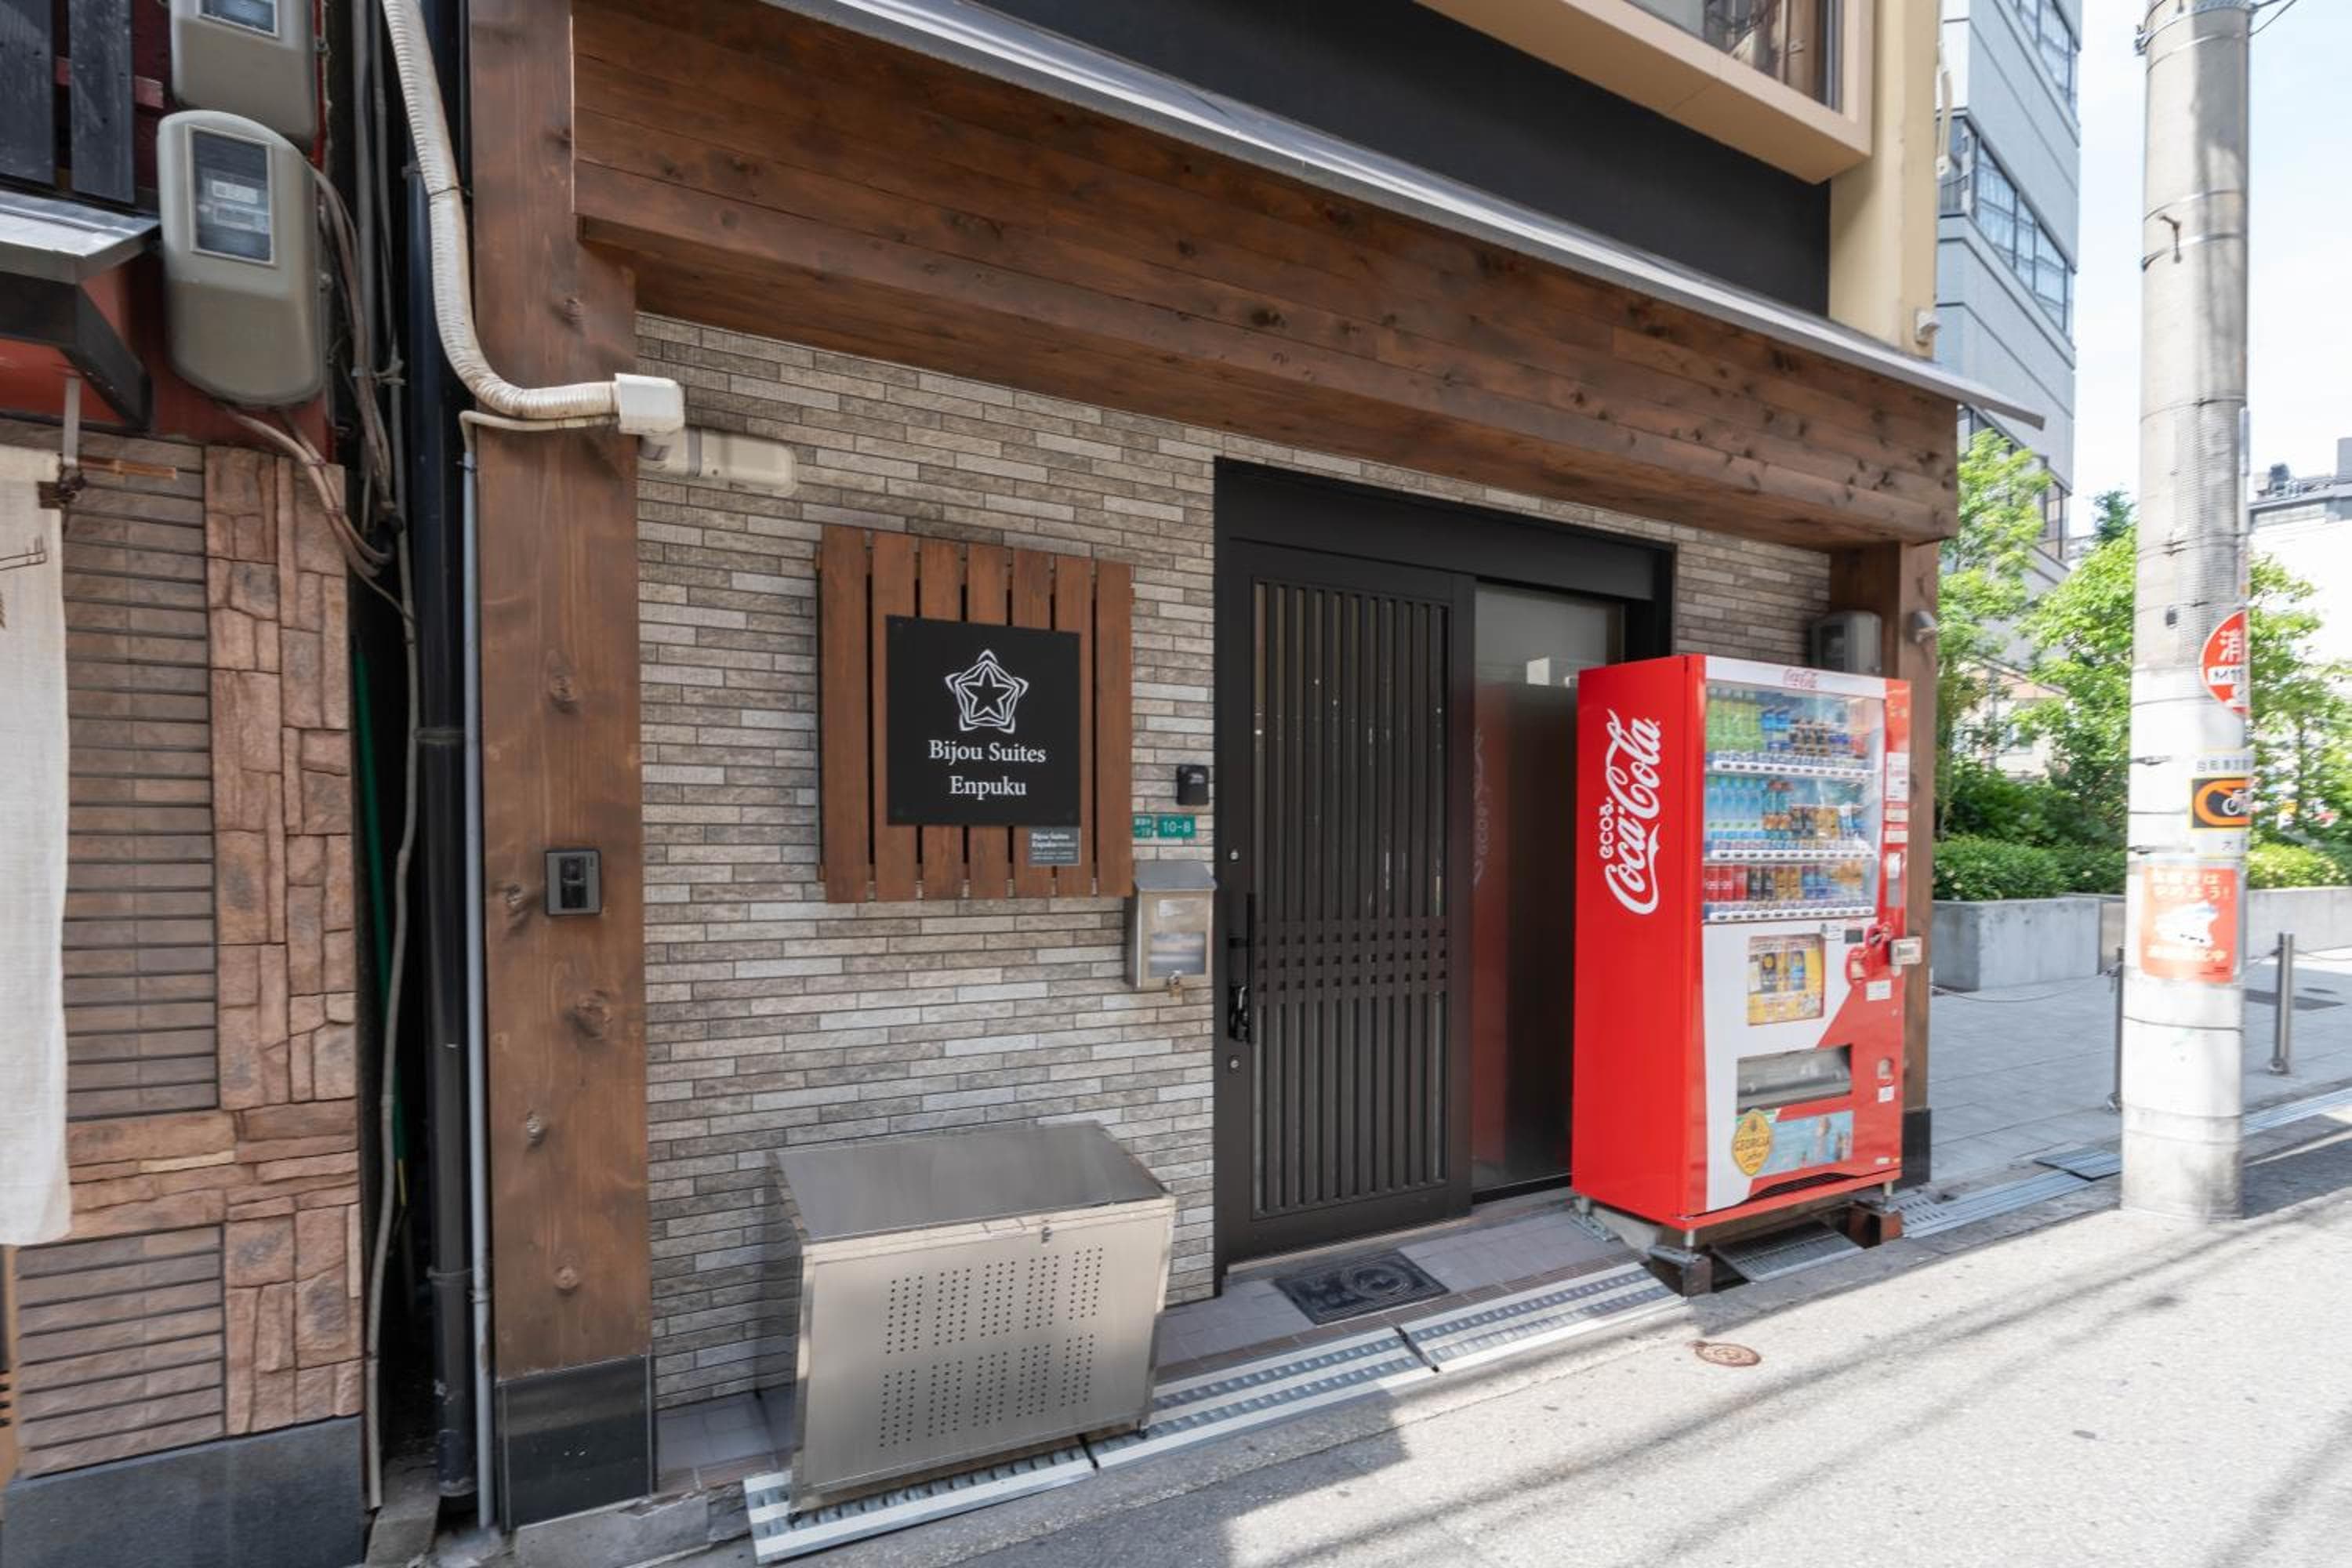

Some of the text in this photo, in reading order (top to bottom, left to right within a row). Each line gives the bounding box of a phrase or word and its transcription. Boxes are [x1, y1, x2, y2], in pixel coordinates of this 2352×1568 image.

[928, 739, 1047, 766] Bijou Suites
[949, 775, 1027, 800] Enpuku
[1605, 707, 1661, 915] Coca-Cola
[1163, 821, 1191, 833] 10-8
